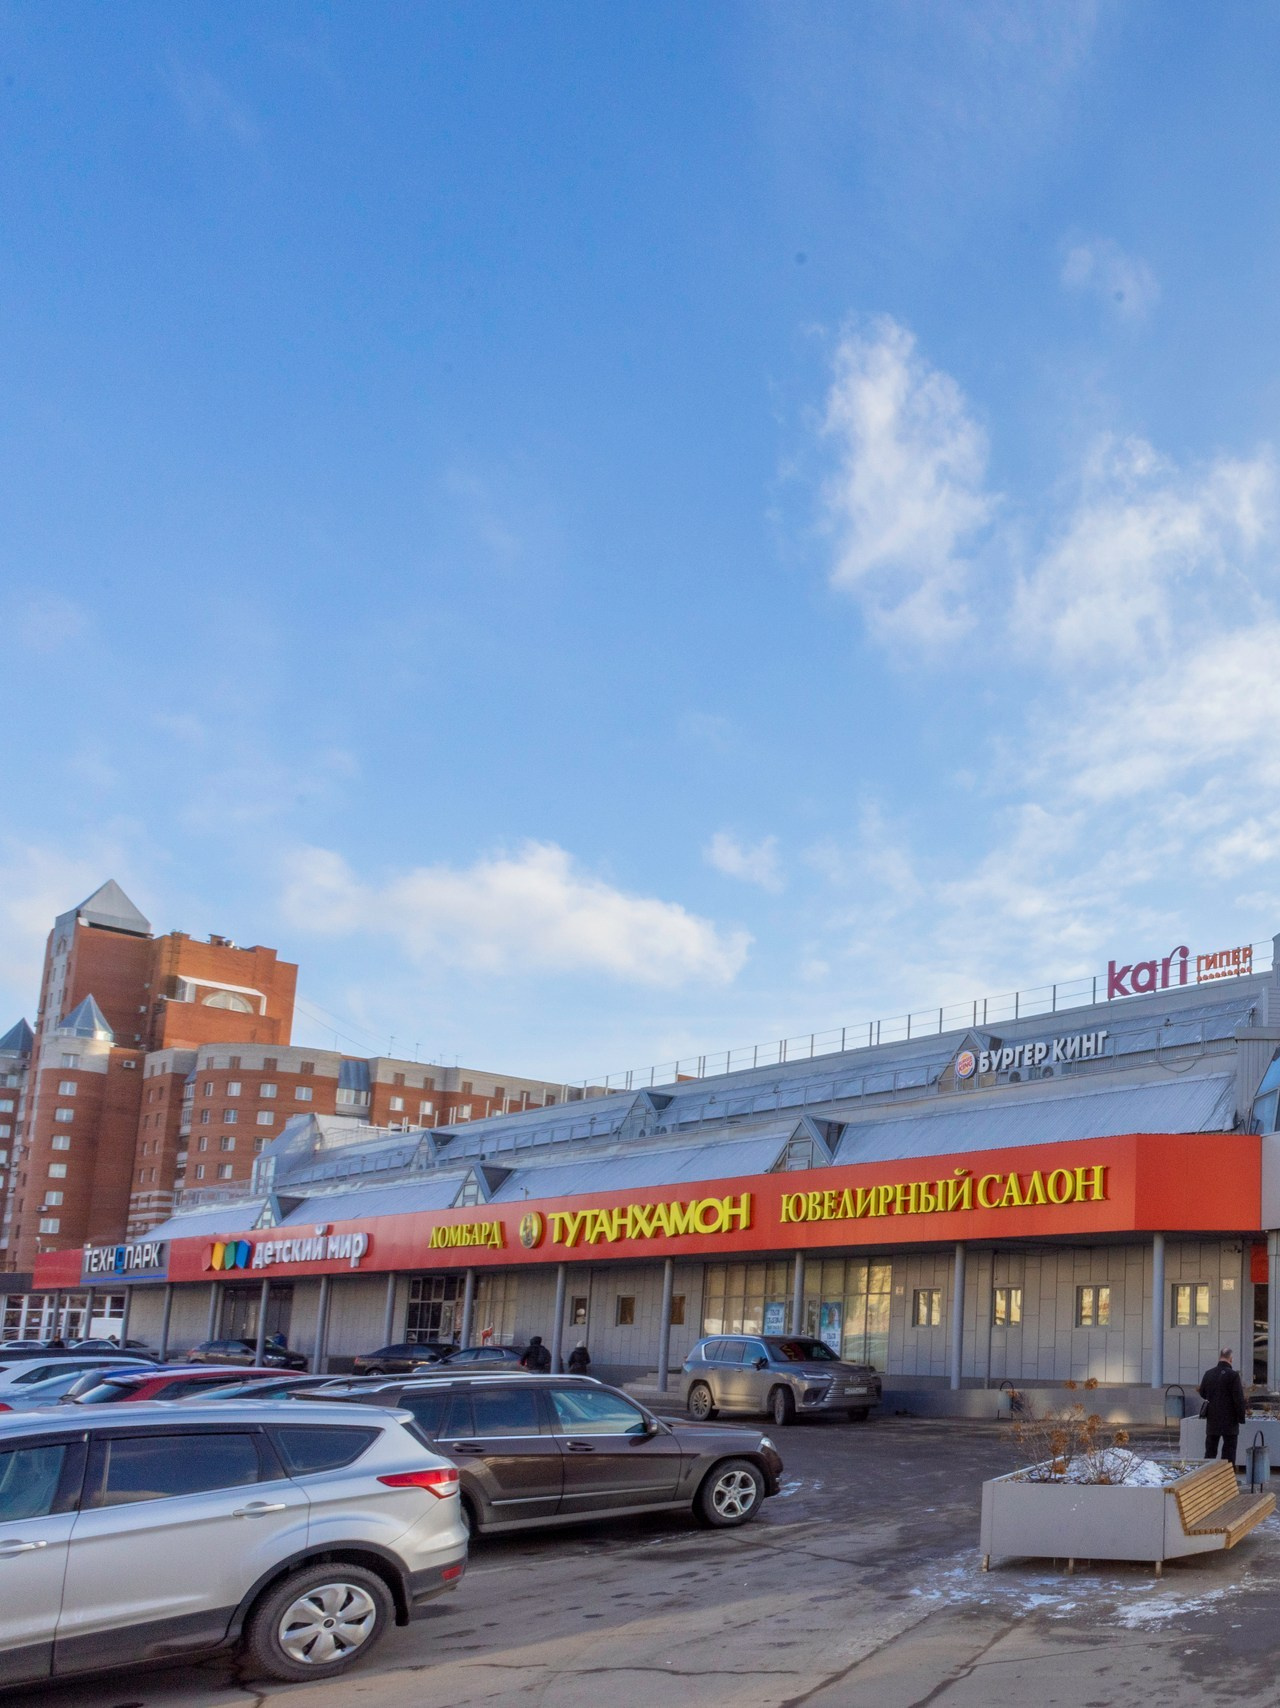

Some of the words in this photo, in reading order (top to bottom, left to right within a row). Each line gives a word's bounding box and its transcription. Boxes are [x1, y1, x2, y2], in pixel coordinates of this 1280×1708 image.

[1107, 945, 1189, 999] kari
[1197, 947, 1253, 972] ГИПЕР
[979, 1042, 1047, 1073] БУРГЕР
[1053, 1030, 1108, 1062] КИНГ
[780, 1168, 972, 1223] ЮВЕЛИРНЫЙ
[977, 1165, 1107, 1209] САЛОН
[428, 1220, 504, 1249] ЛОМБАРД
[548, 1192, 752, 1247] ТУТАНХАМОН
[84, 1242, 161, 1275] ТЕХНОПАРК
[252, 1224, 329, 1269] детский
[327, 1232, 368, 1268] мир
